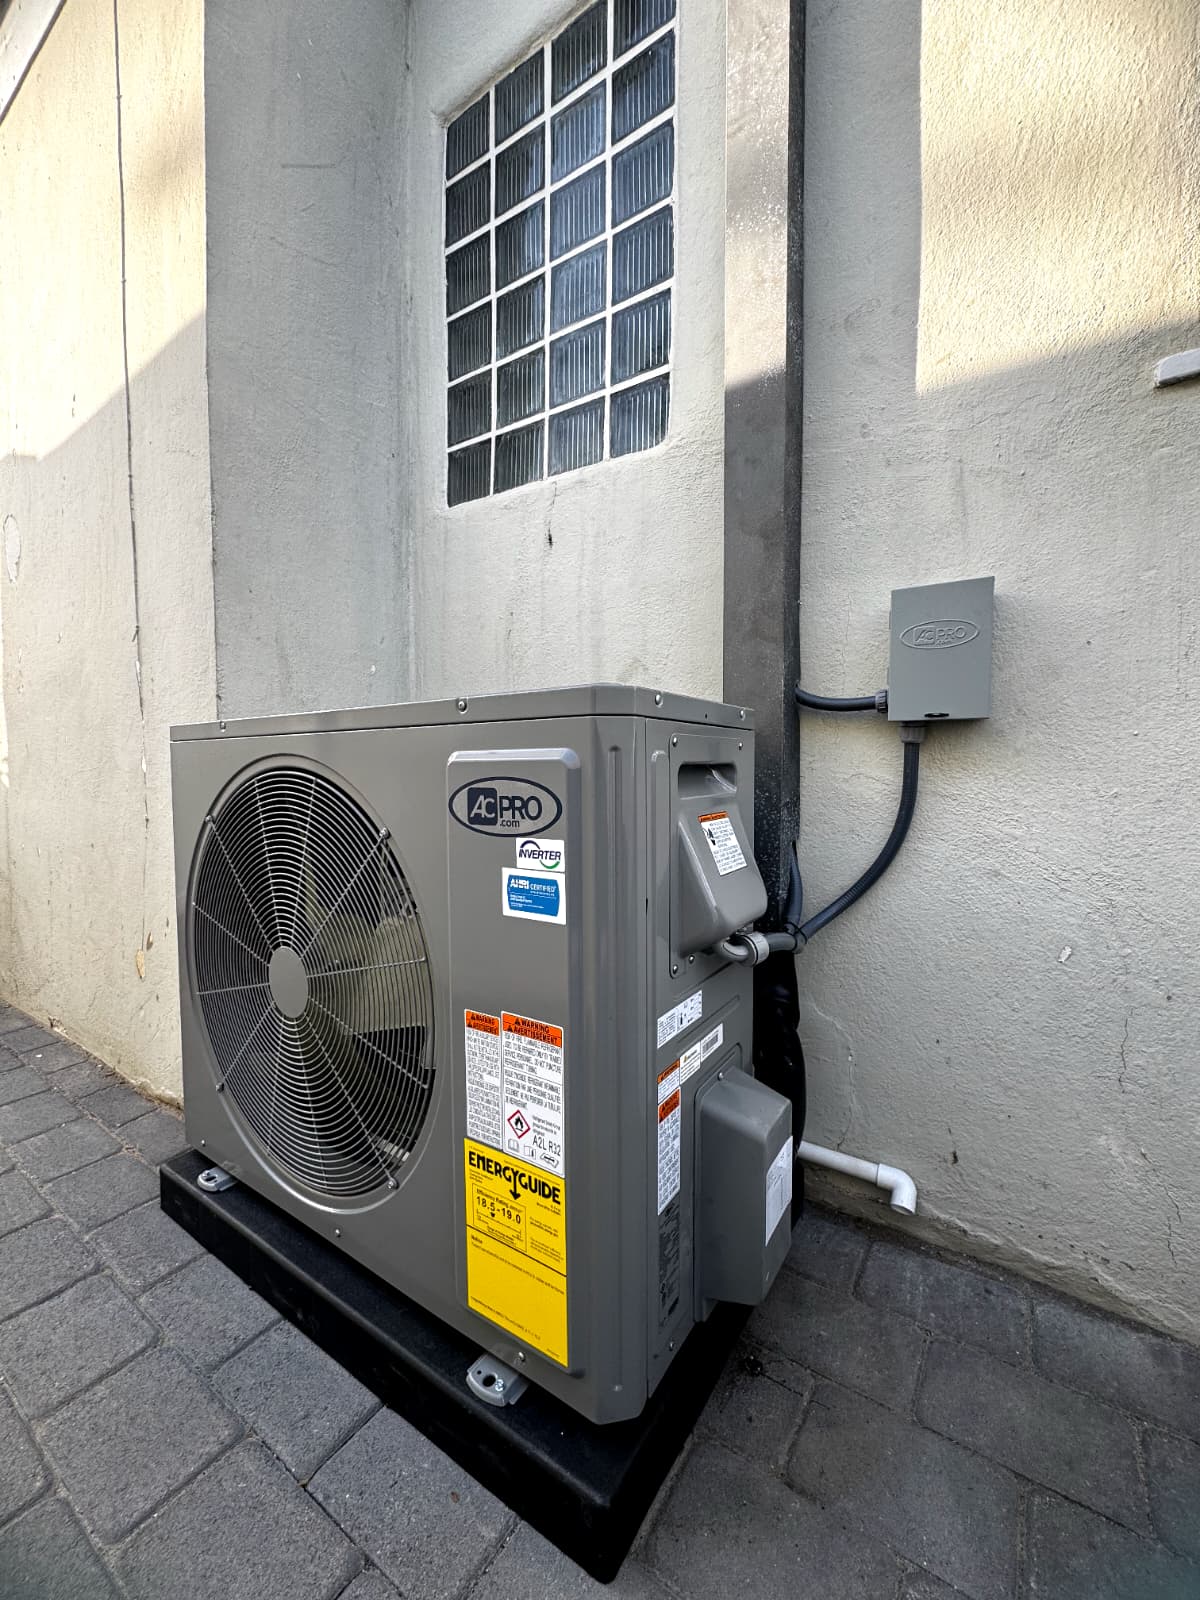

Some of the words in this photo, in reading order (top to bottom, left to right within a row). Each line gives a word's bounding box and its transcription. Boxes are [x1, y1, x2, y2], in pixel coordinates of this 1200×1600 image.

[500, 820, 520, 828] .com
[518, 849, 561, 860] INVERTER
[521, 1019, 550, 1034] WARNING
[532, 1134, 547, 1151] A2L
[548, 1139, 561, 1157] R32
[468, 1150, 561, 1206] ENERGYGUIDE
